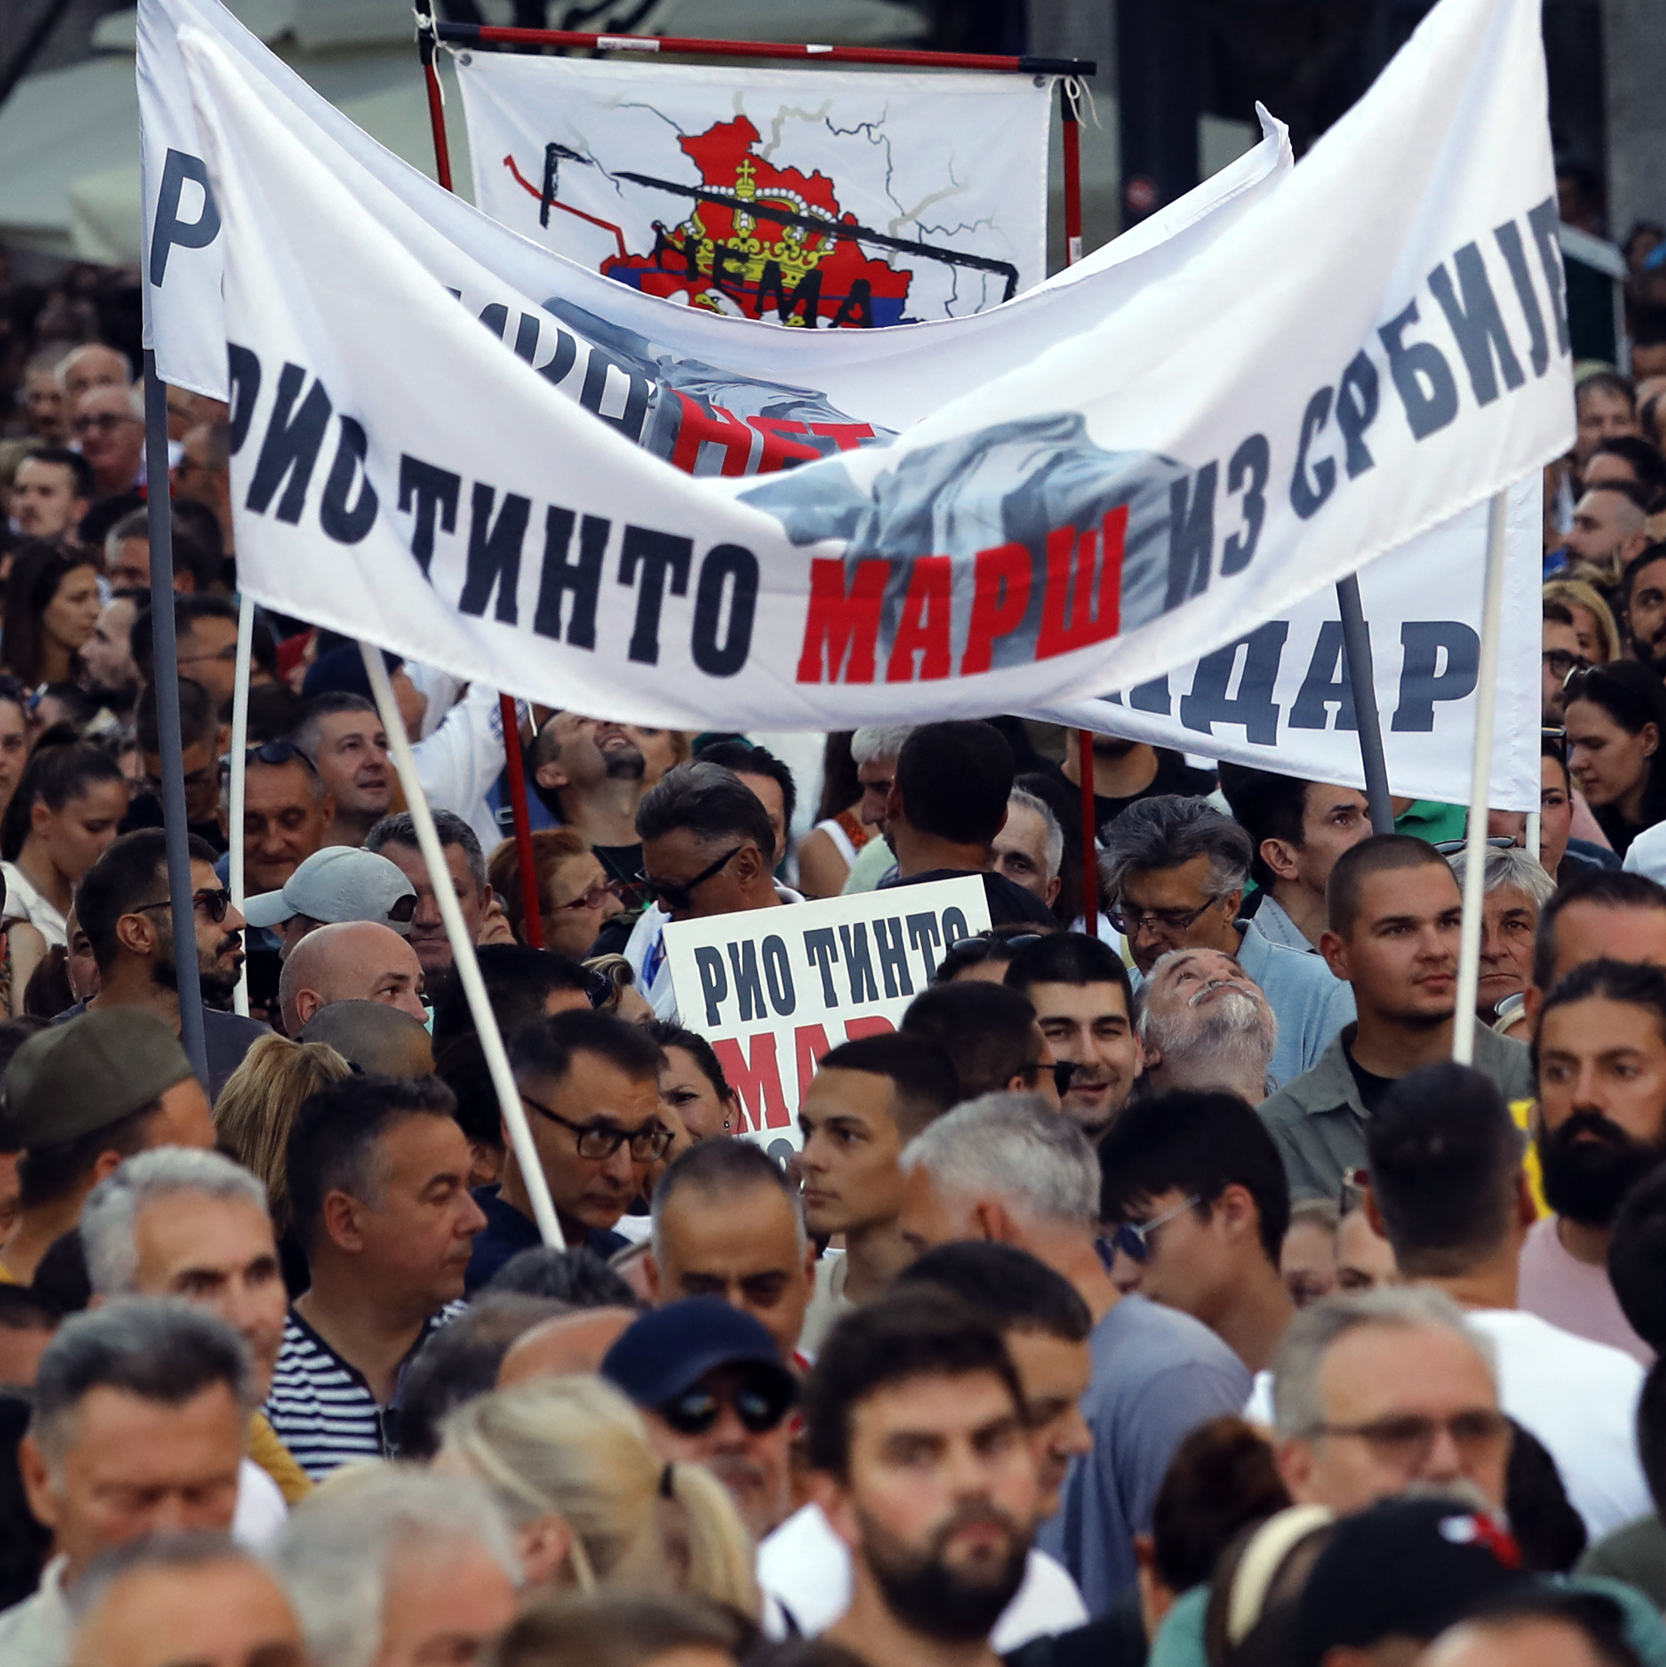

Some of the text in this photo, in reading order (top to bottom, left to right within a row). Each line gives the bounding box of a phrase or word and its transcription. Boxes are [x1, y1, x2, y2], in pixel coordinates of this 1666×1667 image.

[397, 452, 760, 678] ТИНТО
[796, 502, 1130, 685] МАРШ
[1163, 432, 1271, 616] ИЗ
[693, 934, 796, 1027] РИО
